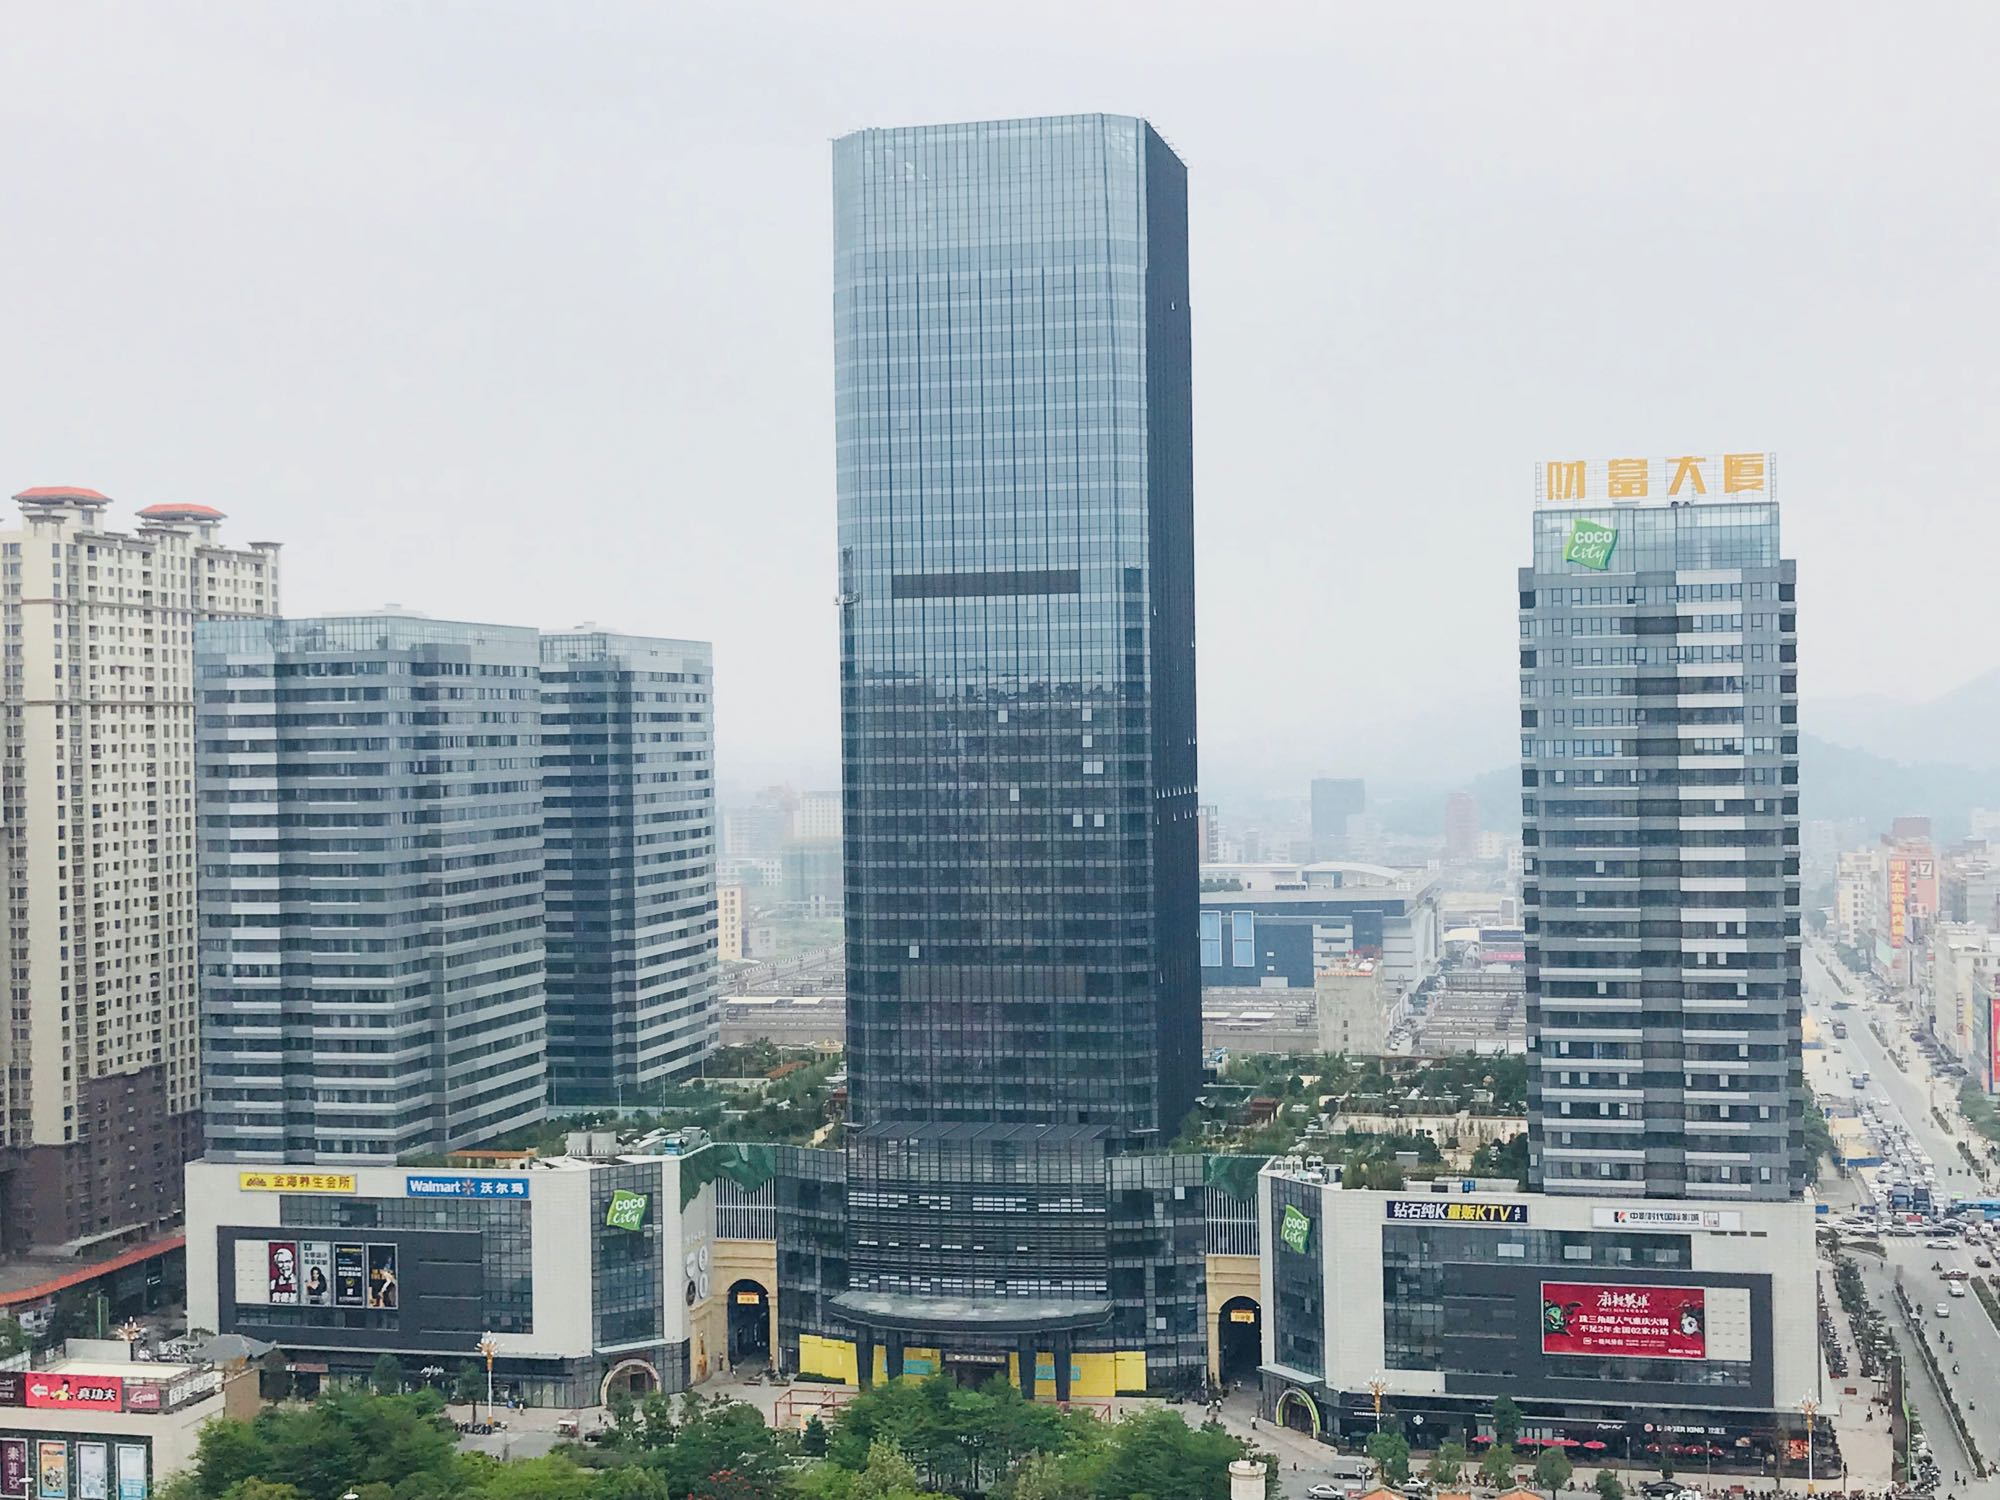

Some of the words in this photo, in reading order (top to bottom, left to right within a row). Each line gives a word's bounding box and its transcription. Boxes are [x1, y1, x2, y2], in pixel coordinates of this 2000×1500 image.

[1547, 453, 1764, 500] 财富大厦
[1574, 529, 1613, 544] COCO
[272, 1175, 350, 1189] 金海养生会所
[410, 1180, 461, 1193] Walmart
[480, 1182, 525, 1195] 沃尔玛
[615, 1198, 645, 1211] COCO
[1286, 1217, 1308, 1230] COCO
[1578, 1315, 1669, 1326] 珠三角超人气重庆火锅
[77, 1386, 117, 1401] 真功夫
